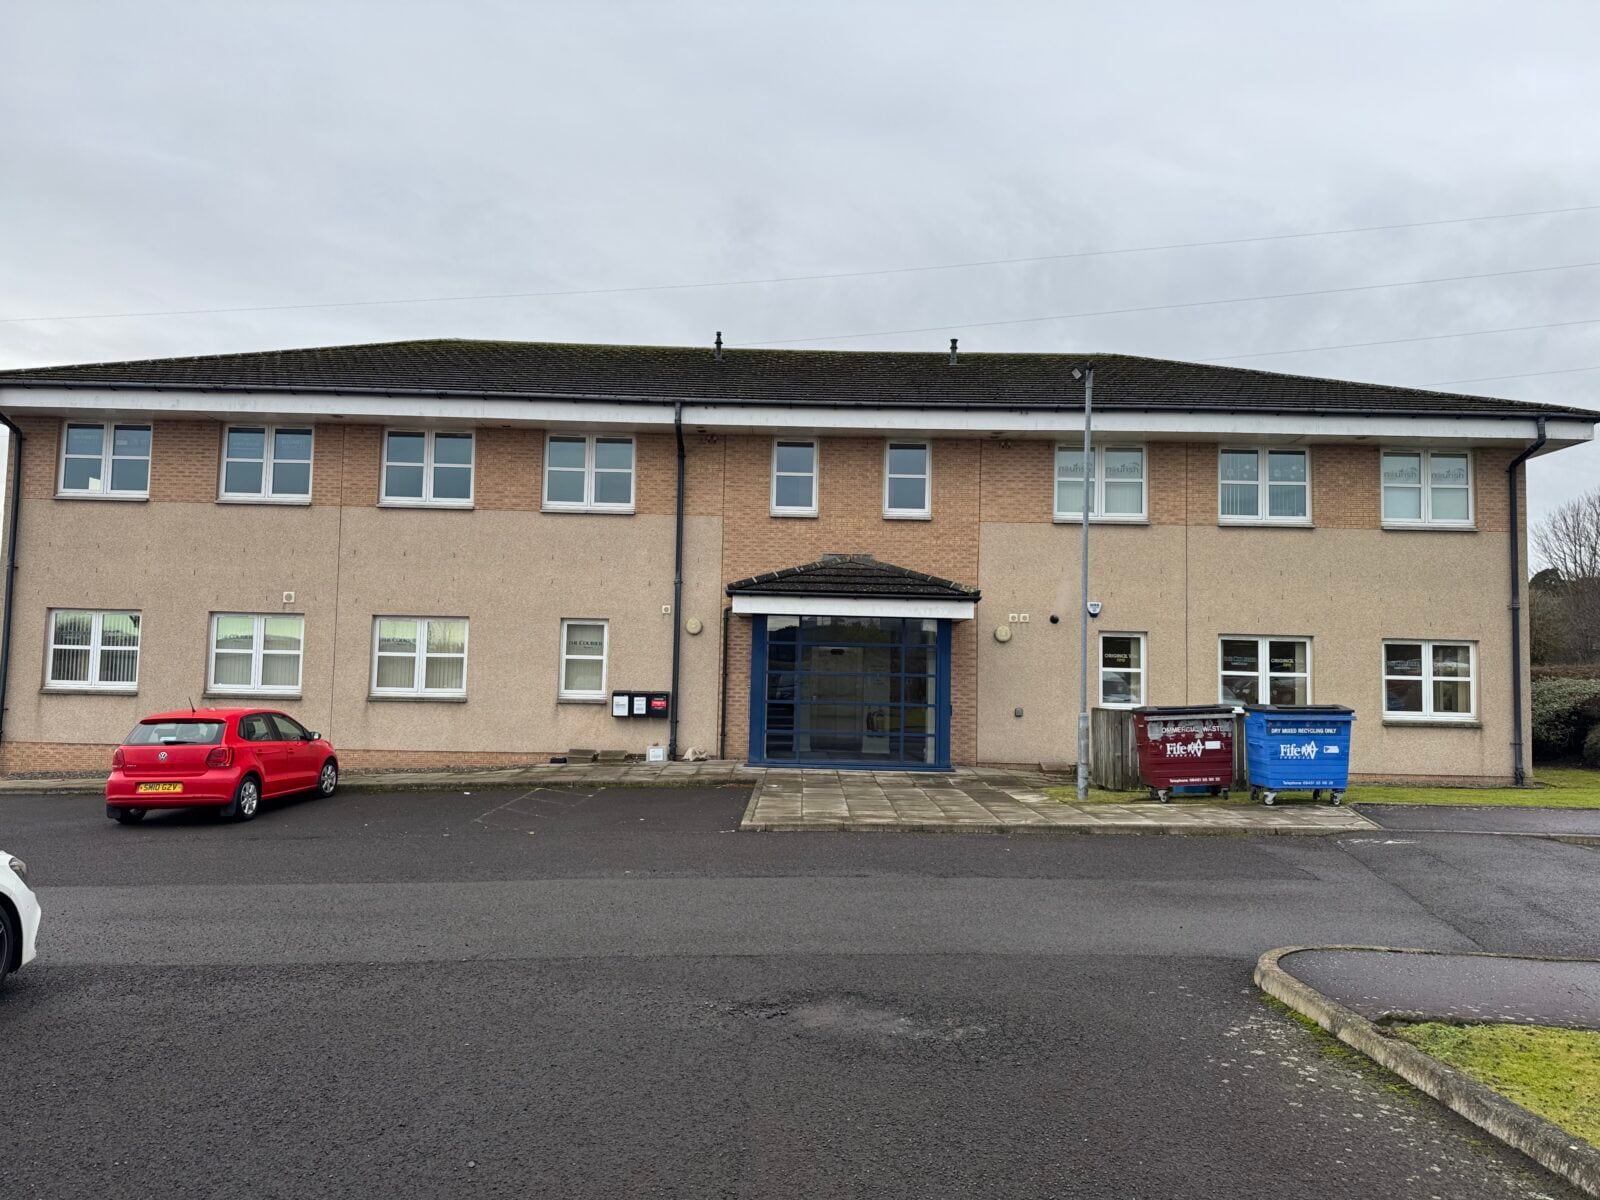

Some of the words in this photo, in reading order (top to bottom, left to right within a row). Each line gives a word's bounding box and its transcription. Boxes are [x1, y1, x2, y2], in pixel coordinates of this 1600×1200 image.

[1166, 741, 1187, 754] Fife
[1279, 743, 1301, 756] Fife
[161, 783, 178, 791] GZV
